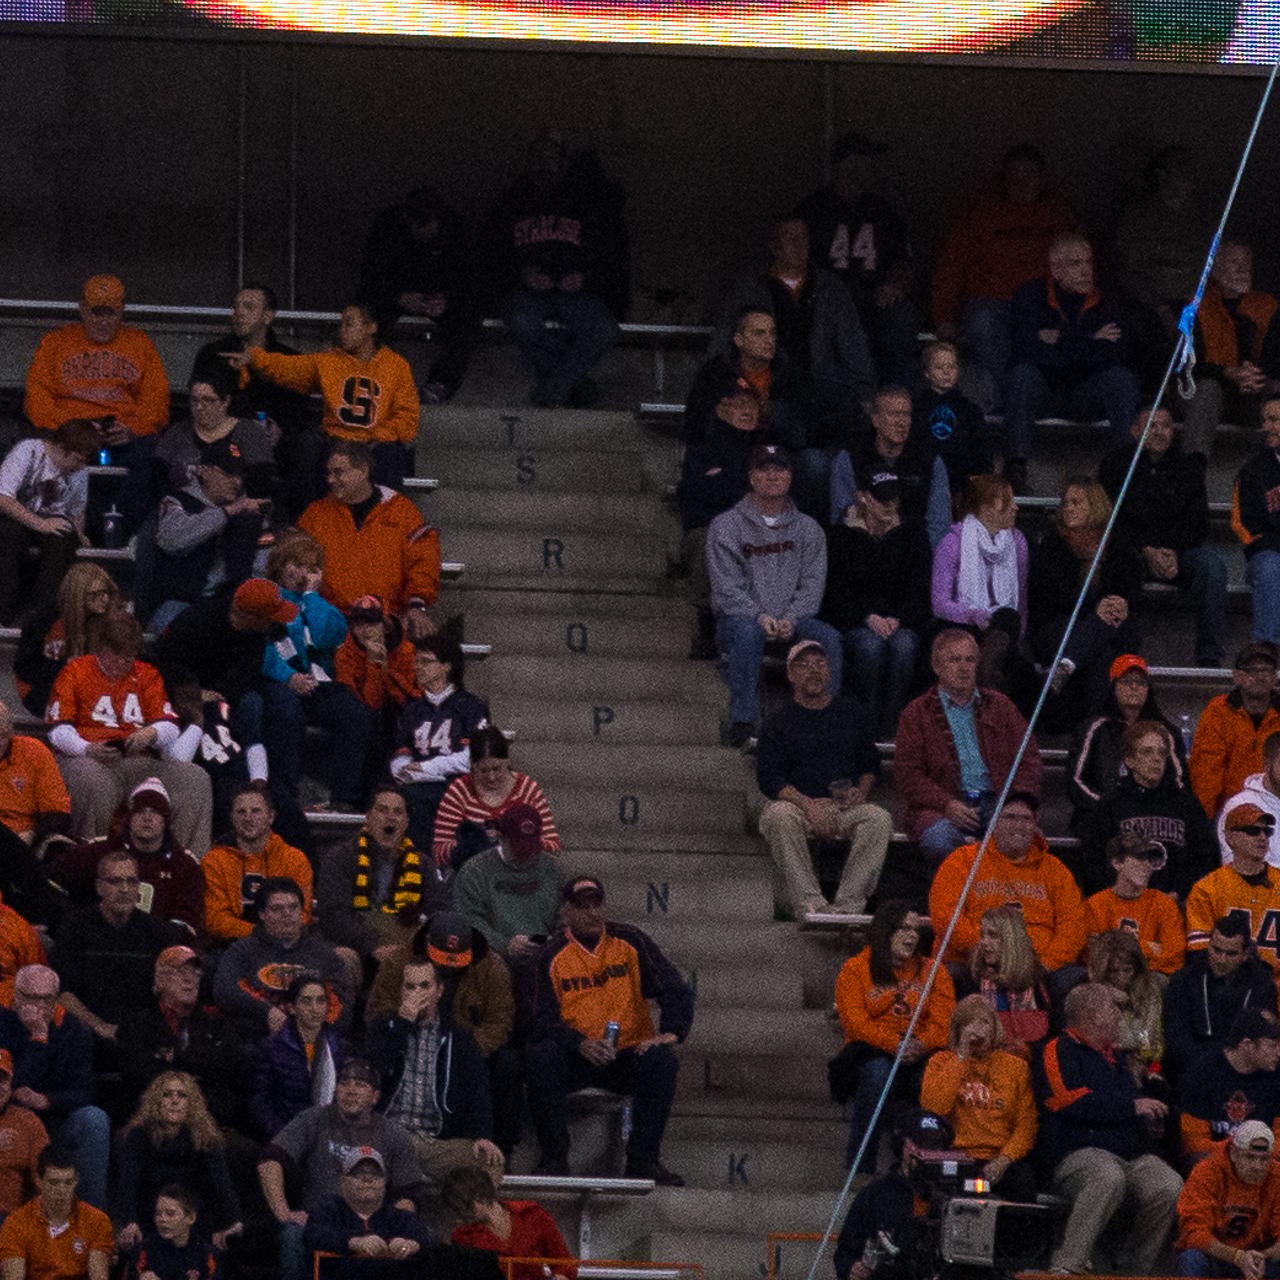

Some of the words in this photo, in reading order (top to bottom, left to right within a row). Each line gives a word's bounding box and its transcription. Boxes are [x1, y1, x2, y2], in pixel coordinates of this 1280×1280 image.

[828, 223, 877, 272] 44
[338, 376, 381, 429] S
[542, 538, 566, 569] R
[92, 693, 145, 731] 44
[592, 705, 616, 737] P
[413, 720, 453, 758] 44
[646, 881, 670, 914] N
[728, 1152, 749, 1186] K
